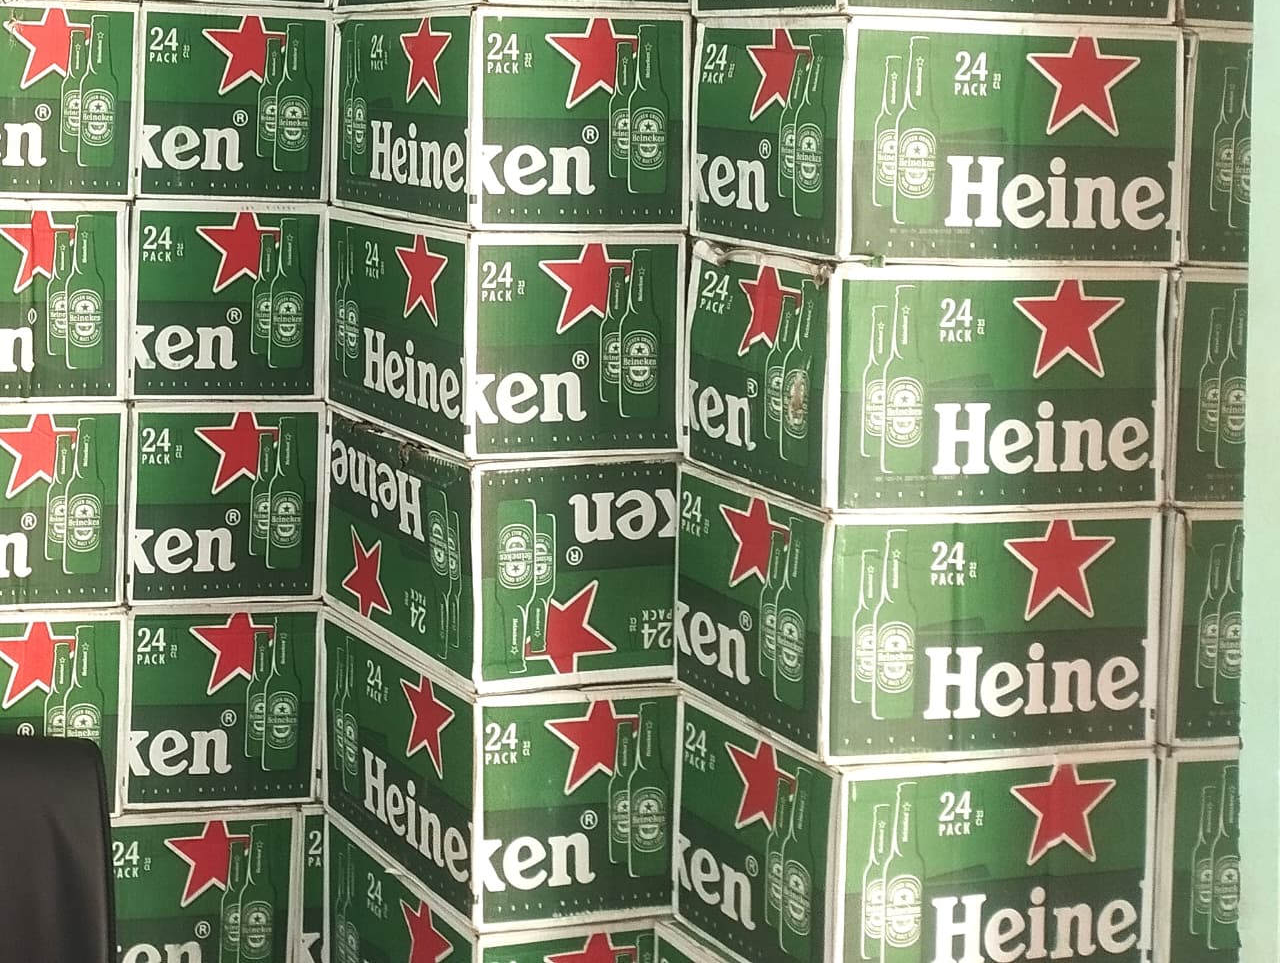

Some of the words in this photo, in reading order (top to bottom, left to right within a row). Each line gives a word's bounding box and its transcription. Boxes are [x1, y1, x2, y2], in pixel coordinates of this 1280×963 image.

[150, 27, 178, 51] 24
[488, 62, 518, 74] PACK
[955, 83, 987, 96] PACK
[369, 119, 469, 194] Heine
[944, 154, 1180, 231] Heine
[143, 226, 172, 249] 24
[481, 290, 512, 302] PACK
[940, 330, 971, 342] PACK
[364, 328, 465, 420] Heine
[933, 402, 1160, 476] Heine
[931, 573, 964, 586] PACK
[924, 637, 1147, 720] Heine
[361, 746, 475, 888] Heine
[939, 822, 970, 836] PACK
[930, 879, 1152, 963] Heine
